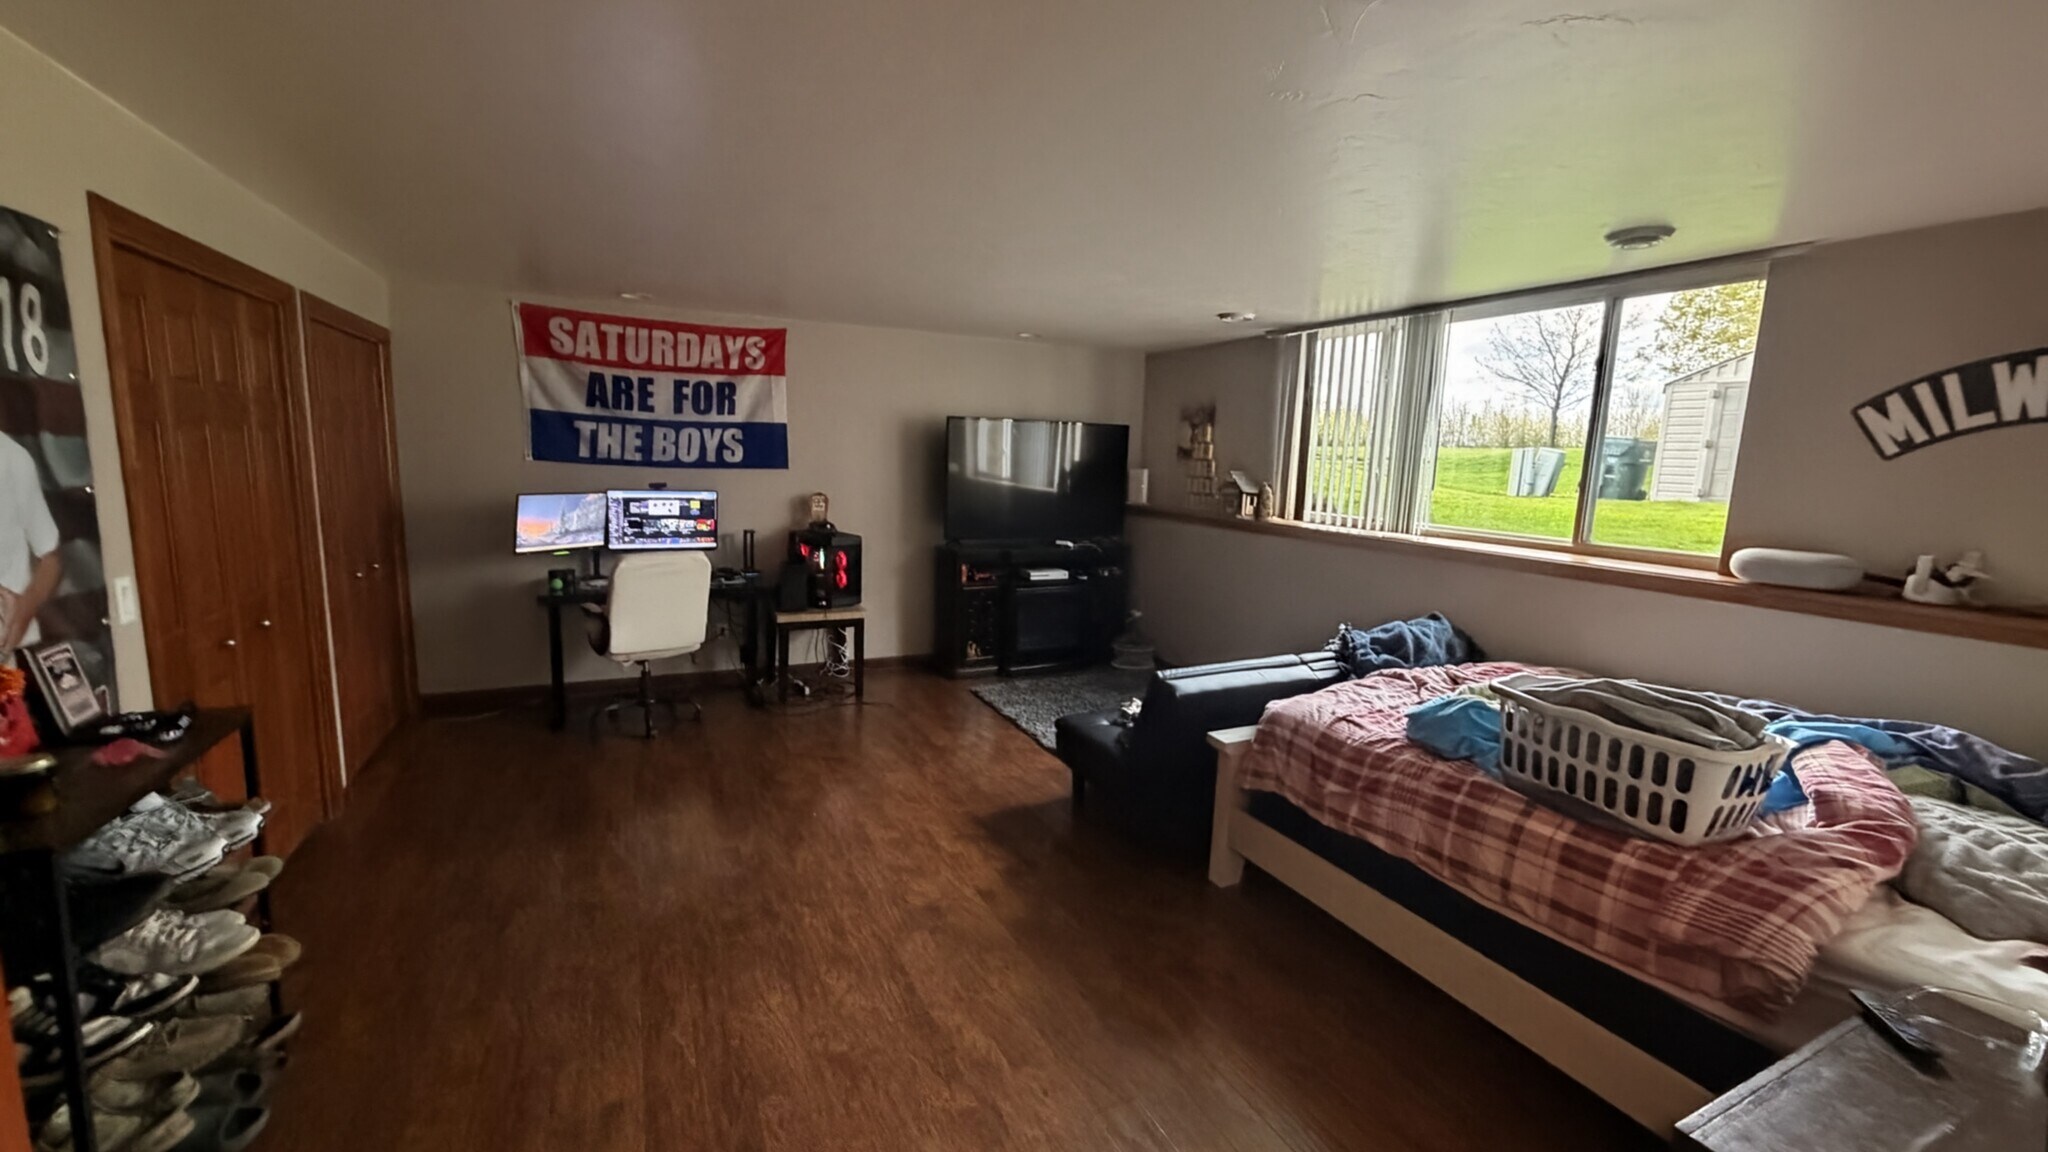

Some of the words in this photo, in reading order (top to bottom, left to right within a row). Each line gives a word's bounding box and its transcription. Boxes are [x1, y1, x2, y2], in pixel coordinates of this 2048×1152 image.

[548, 316, 766, 371] SATURDAYS
[585, 371, 655, 413] ARE
[673, 379, 737, 416] FOR
[573, 420, 643, 462] THE
[651, 426, 744, 464] BOYS
